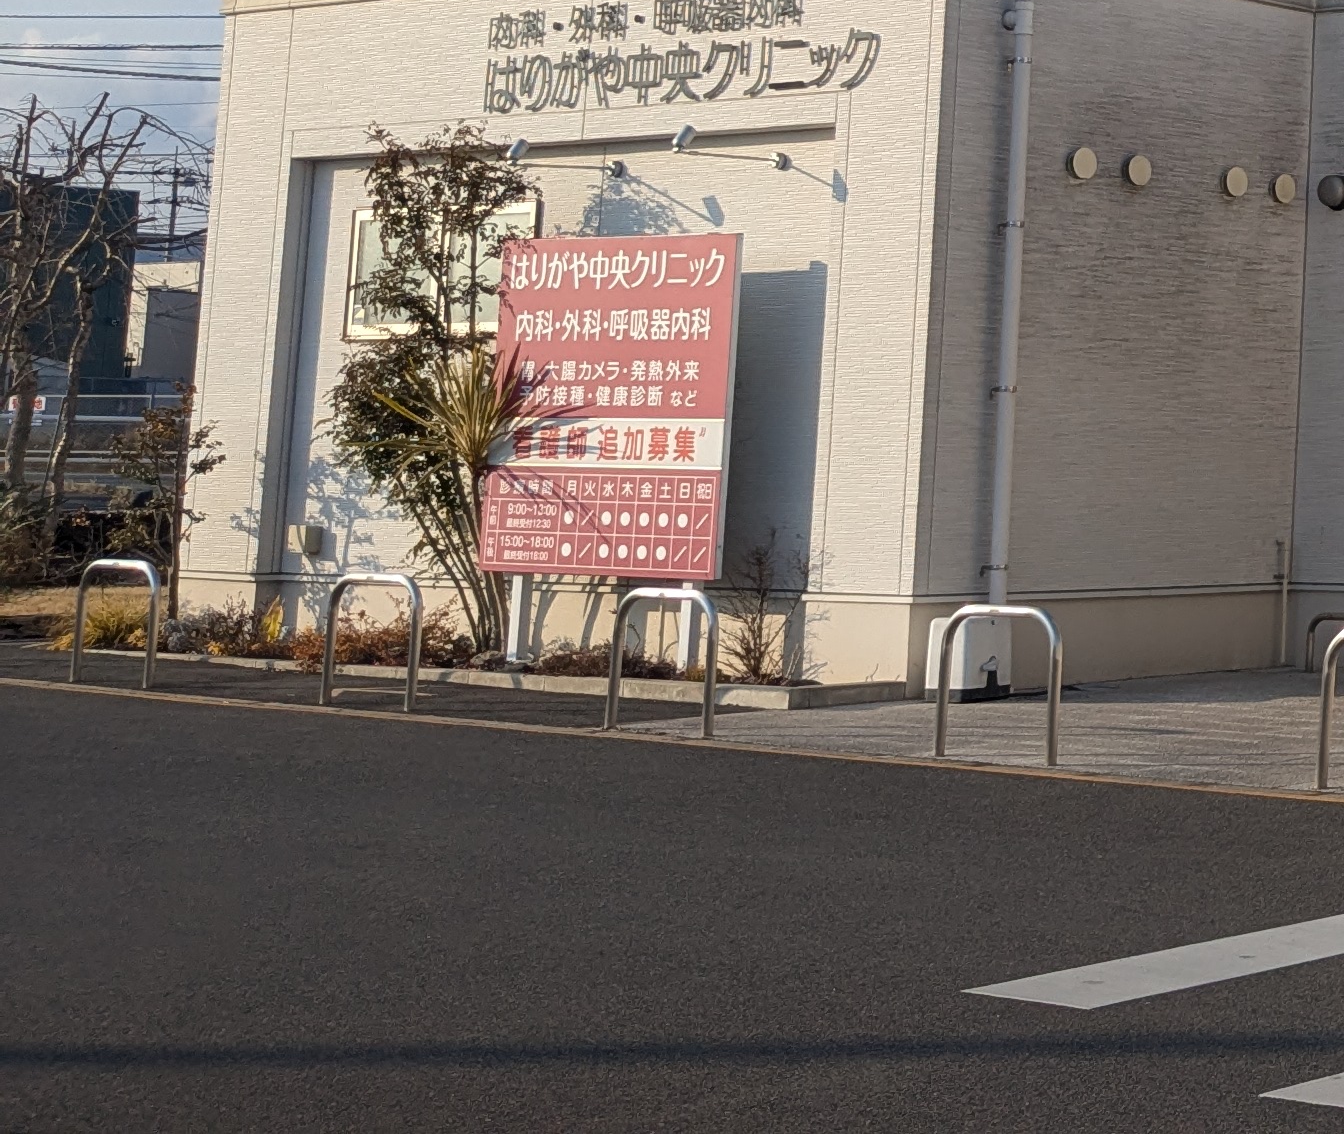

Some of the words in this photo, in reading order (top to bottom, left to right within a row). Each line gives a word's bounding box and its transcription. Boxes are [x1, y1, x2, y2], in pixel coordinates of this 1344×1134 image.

[484, 26, 880, 113] はりがや中央クリニック
[510, 248, 726, 290] はりがや中央クリニック
[515, 307, 711, 342] 内科・外科・呼吸器内科
[670, 389, 698, 407] など
[566, 479, 577, 496] 月
[583, 480, 597, 497] 火
[602, 480, 615, 497] 水
[621, 481, 634, 498] 木
[640, 481, 653, 498] 金
[659, 482, 672, 499] 土
[679, 482, 691, 499] 日
[507, 502, 558, 516] 9:00~13:00
[500, 535, 555, 549] 15:00~18:00
